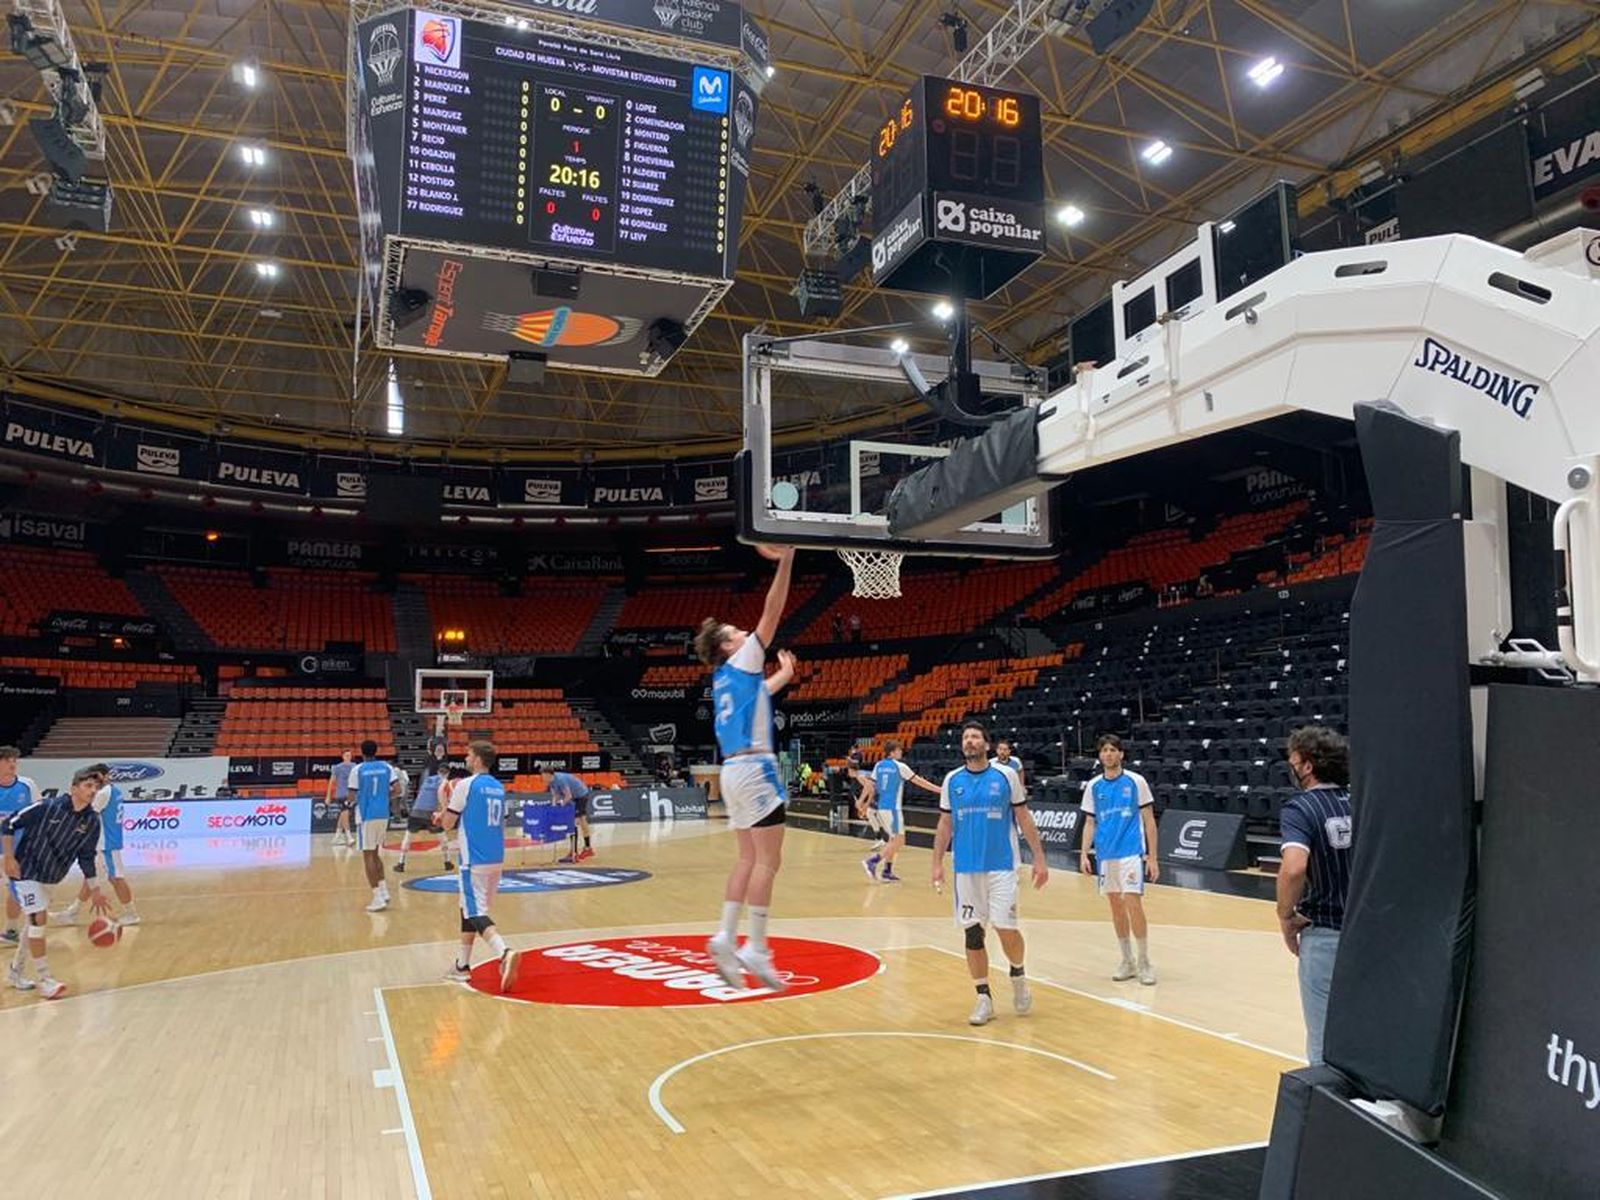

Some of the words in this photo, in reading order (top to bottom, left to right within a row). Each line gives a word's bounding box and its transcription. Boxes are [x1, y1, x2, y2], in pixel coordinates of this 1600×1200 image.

[424, 65, 470, 81] NICKERSON
[522, 81, 529, 92] 0
[495, 46, 525, 61] CIUDAD
[526, 52, 536, 62] DE
[537, 54, 566, 67] HUELVA
[592, 64, 630, 80] MOVISTAR
[630, 71, 677, 88] ESTUDIANTES
[414, 76, 420, 87] 2
[521, 94, 528, 104] 0
[545, 87, 566, 98] LOCAL
[413, 90, 419, 101] 3
[423, 92, 448, 105] PEREZ
[521, 108, 528, 118] 0
[551, 97, 560, 111] 0
[596, 105, 605, 119] 0
[626, 99, 633, 110] 0
[635, 102, 657, 114] LOPEZ
[412, 104, 419, 114] 4
[520, 121, 527, 131] 0
[625, 113, 632, 123] 2
[721, 130, 728, 140] 0
[412, 117, 418, 128] 5
[422, 120, 468, 135] MONTANER
[519, 134, 527, 145] 0
[625, 126, 631, 136] 4
[634, 128, 670, 142] MONTERO
[720, 142, 727, 152] 0
[412, 130, 418, 141] 7
[421, 133, 445, 145] RECIO
[519, 147, 526, 158] 0
[573, 140, 580, 153] 1
[624, 138, 630, 149] 5
[633, 141, 669, 154] FIGUEROA
[720, 155, 727, 165] 0
[410, 145, 420, 155] 10
[519, 161, 526, 171] 0
[624, 151, 630, 162] 8
[719, 167, 726, 177] 0
[409, 159, 419, 169] 11
[421, 161, 455, 174] CEBOLLA
[518, 174, 525, 184] 0
[549, 164, 600, 188] 20:16
[622, 165, 631, 174] 11
[632, 167, 667, 180] ALDERETE
[719, 180, 726, 190] 0
[408, 173, 419, 182] 12
[420, 175, 455, 187] POSTIGO
[517, 188, 525, 198] 0
[539, 187, 566, 198] FALTES
[582, 193, 609, 204] FALTES
[622, 178, 631, 187] 12
[632, 180, 660, 191] SUAREZ
[718, 193, 725, 203] 0
[407, 186, 418, 196] 25
[419, 188, 452, 200] BLANCO
[517, 201, 524, 212] 0
[547, 202, 555, 214] 0
[592, 208, 601, 221] 0
[631, 193, 675, 207] DOMINGUEZ
[718, 205, 725, 215] 0
[407, 199, 418, 209] 77
[419, 202, 464, 216] RODRIGUEZ
[516, 214, 524, 225] 0
[620, 204, 630, 213] 22
[631, 205, 653, 217] LOPEZ
[717, 218, 724, 228] 0
[970, 207, 1016, 225] caixa
[551, 231, 594, 246] Esfuerzo
[552, 223, 586, 236] Cultura
[619, 217, 629, 226] 44
[630, 218, 668, 232] GONZALEZ
[717, 231, 724, 241] 0
[619, 229, 629, 239] 77
[630, 231, 647, 242] LEVY
[716, 243, 723, 254] 0
[887, 218, 921, 261] popular
[969, 220, 1042, 241] popular
[1414, 336, 1540, 418] SPALDING
[5, 422, 95, 460] PULEVA
[140, 447, 177, 461] PULEVA
[219, 462, 300, 488] PULEVA
[528, 482, 559, 491] PULEVA
[697, 479, 726, 489] PULEVA
[594, 487, 663, 503] PULEVA
[14, 513, 85, 541] isaval
[207, 814, 287, 828] SECOMOTO
[487, 798, 502, 827] 10
[24, 893, 35, 907] 12
[962, 904, 975, 919] 77
